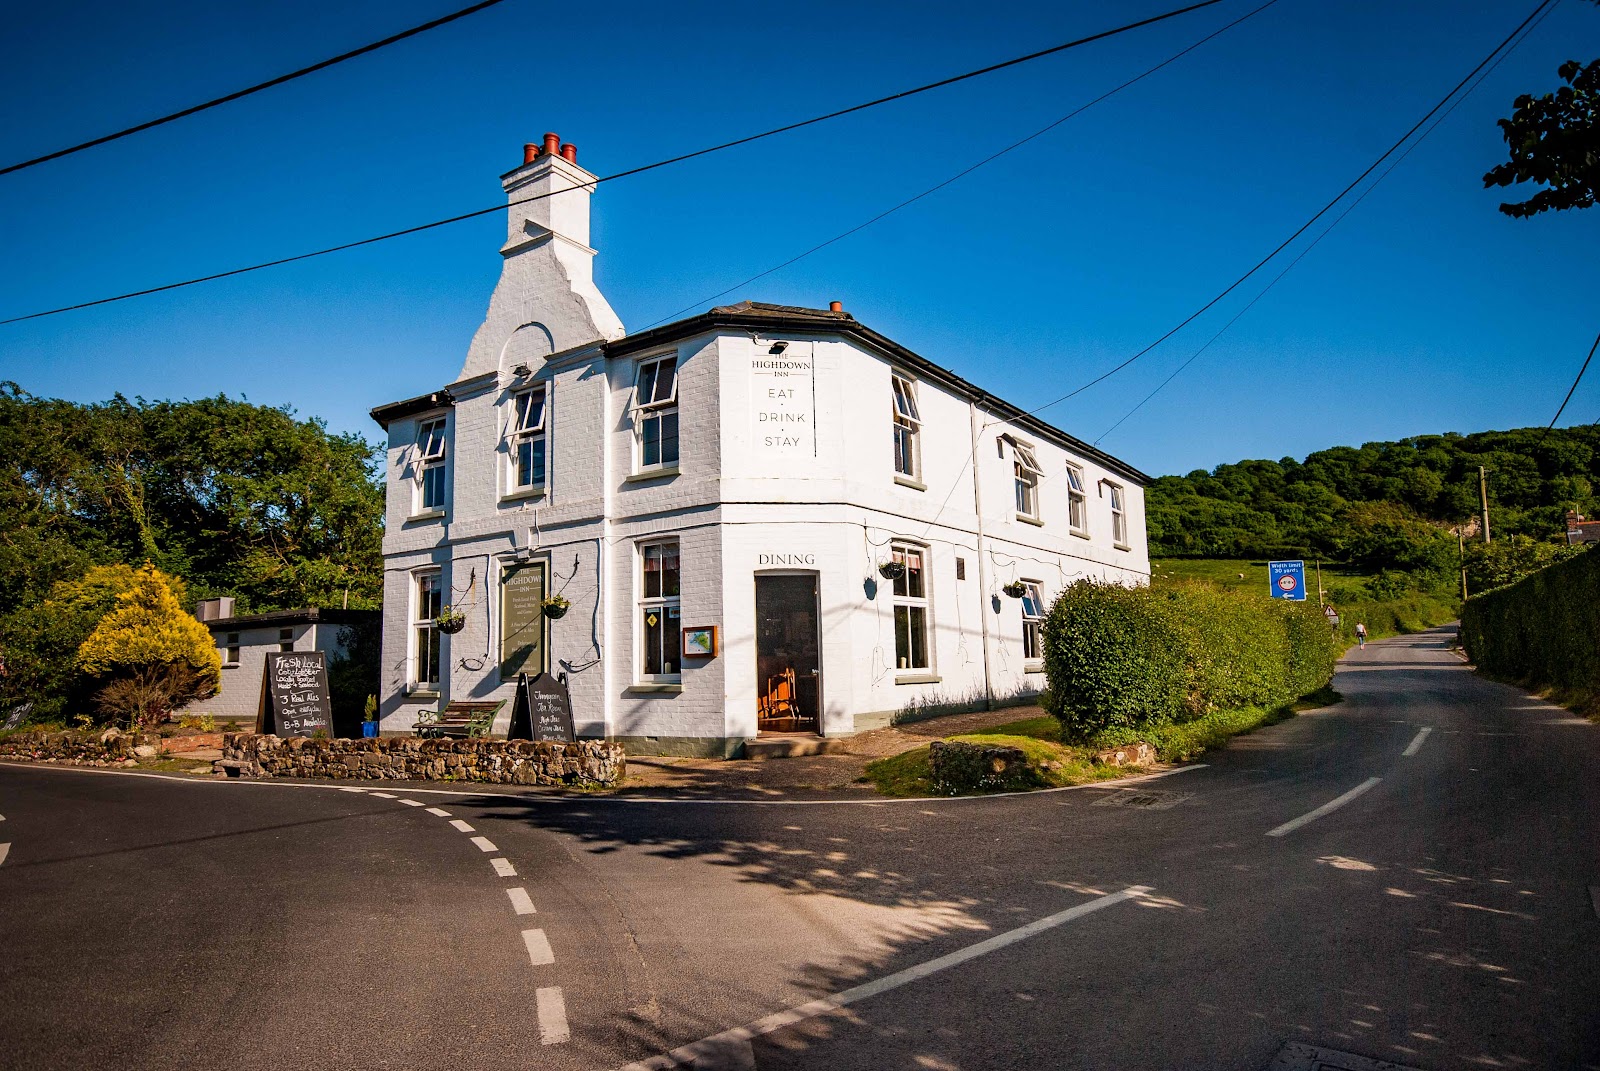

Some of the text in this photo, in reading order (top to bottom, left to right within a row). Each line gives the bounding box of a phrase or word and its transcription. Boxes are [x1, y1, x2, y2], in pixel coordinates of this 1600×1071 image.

[752, 361, 811, 370] HIGHDOWN
[768, 388, 795, 399] EAT
[759, 412, 806, 423] DRINK
[765, 436, 800, 447] STAY
[759, 554, 815, 564] DINING
[276, 656, 323, 669] Fresh Local
[280, 693, 320, 704] 3 Real Ales
